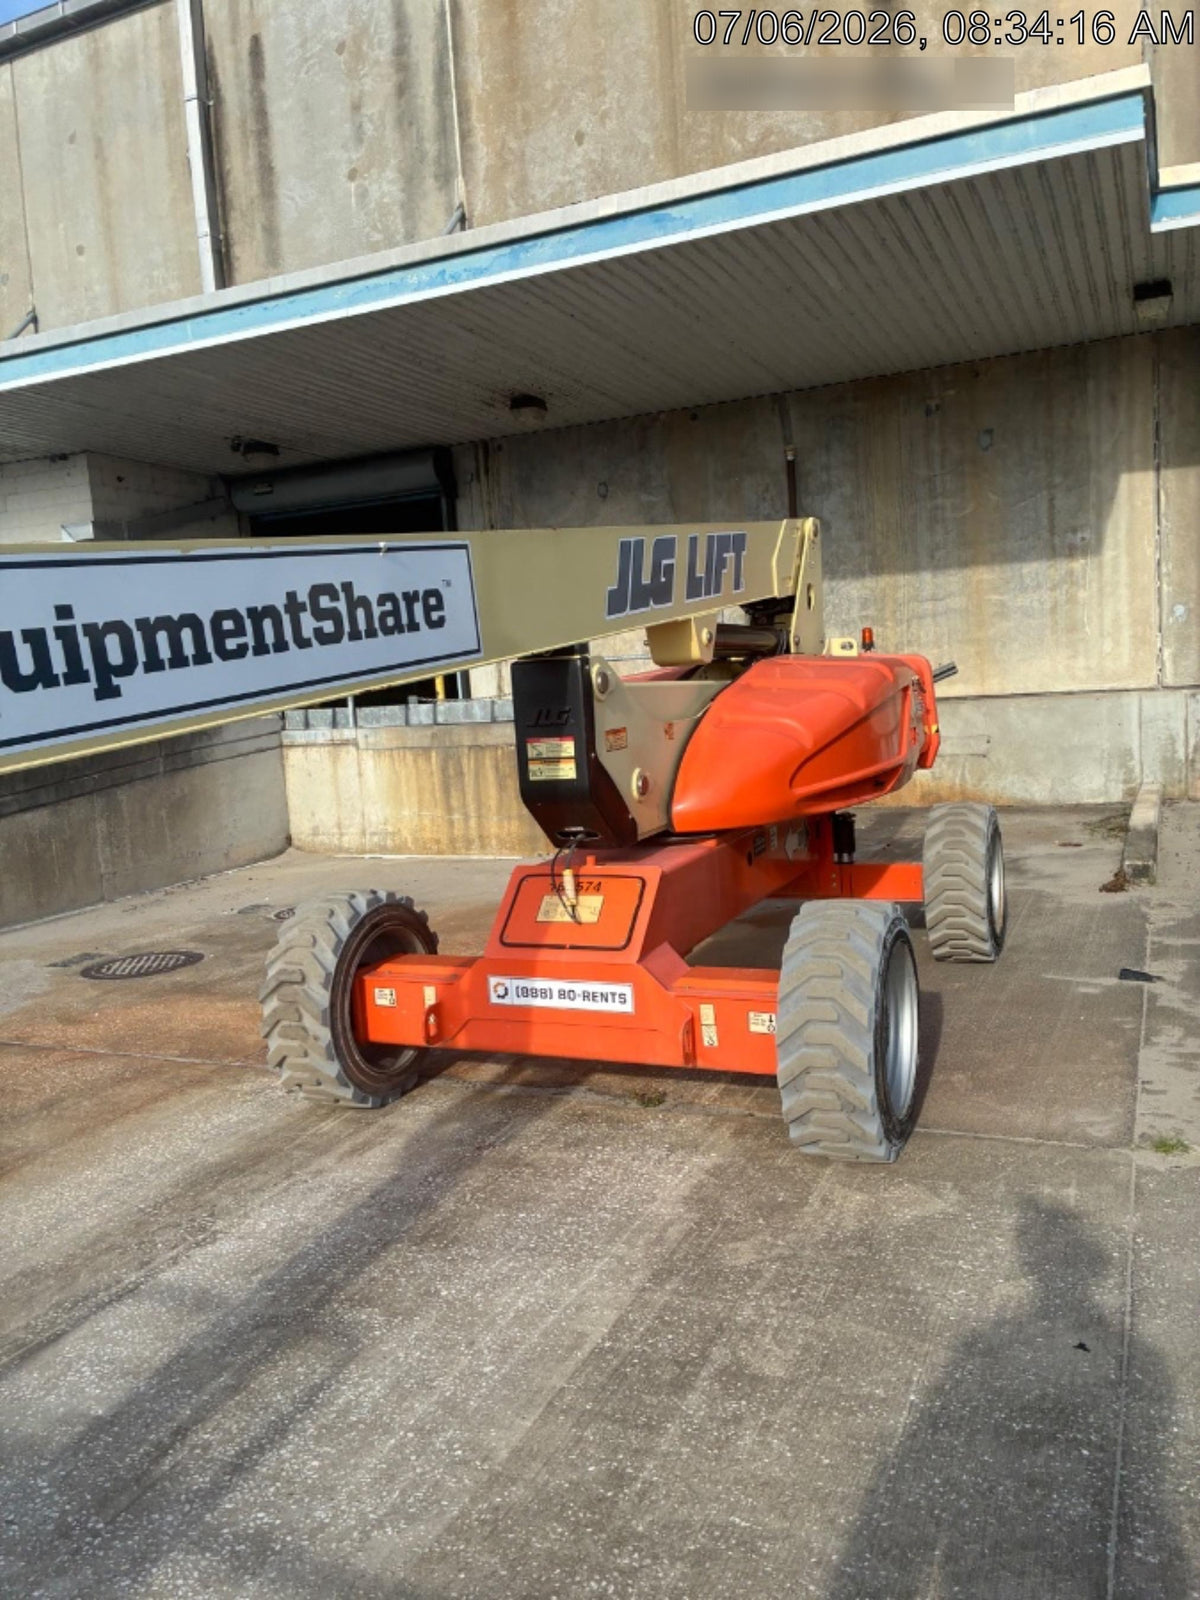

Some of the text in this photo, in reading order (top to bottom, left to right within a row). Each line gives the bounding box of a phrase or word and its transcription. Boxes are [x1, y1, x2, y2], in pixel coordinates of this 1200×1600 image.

[606, 531, 747, 620] JLG LIFT
[0, 580, 446, 701] uipmentShare
[515, 985, 553, 1000] (888)
